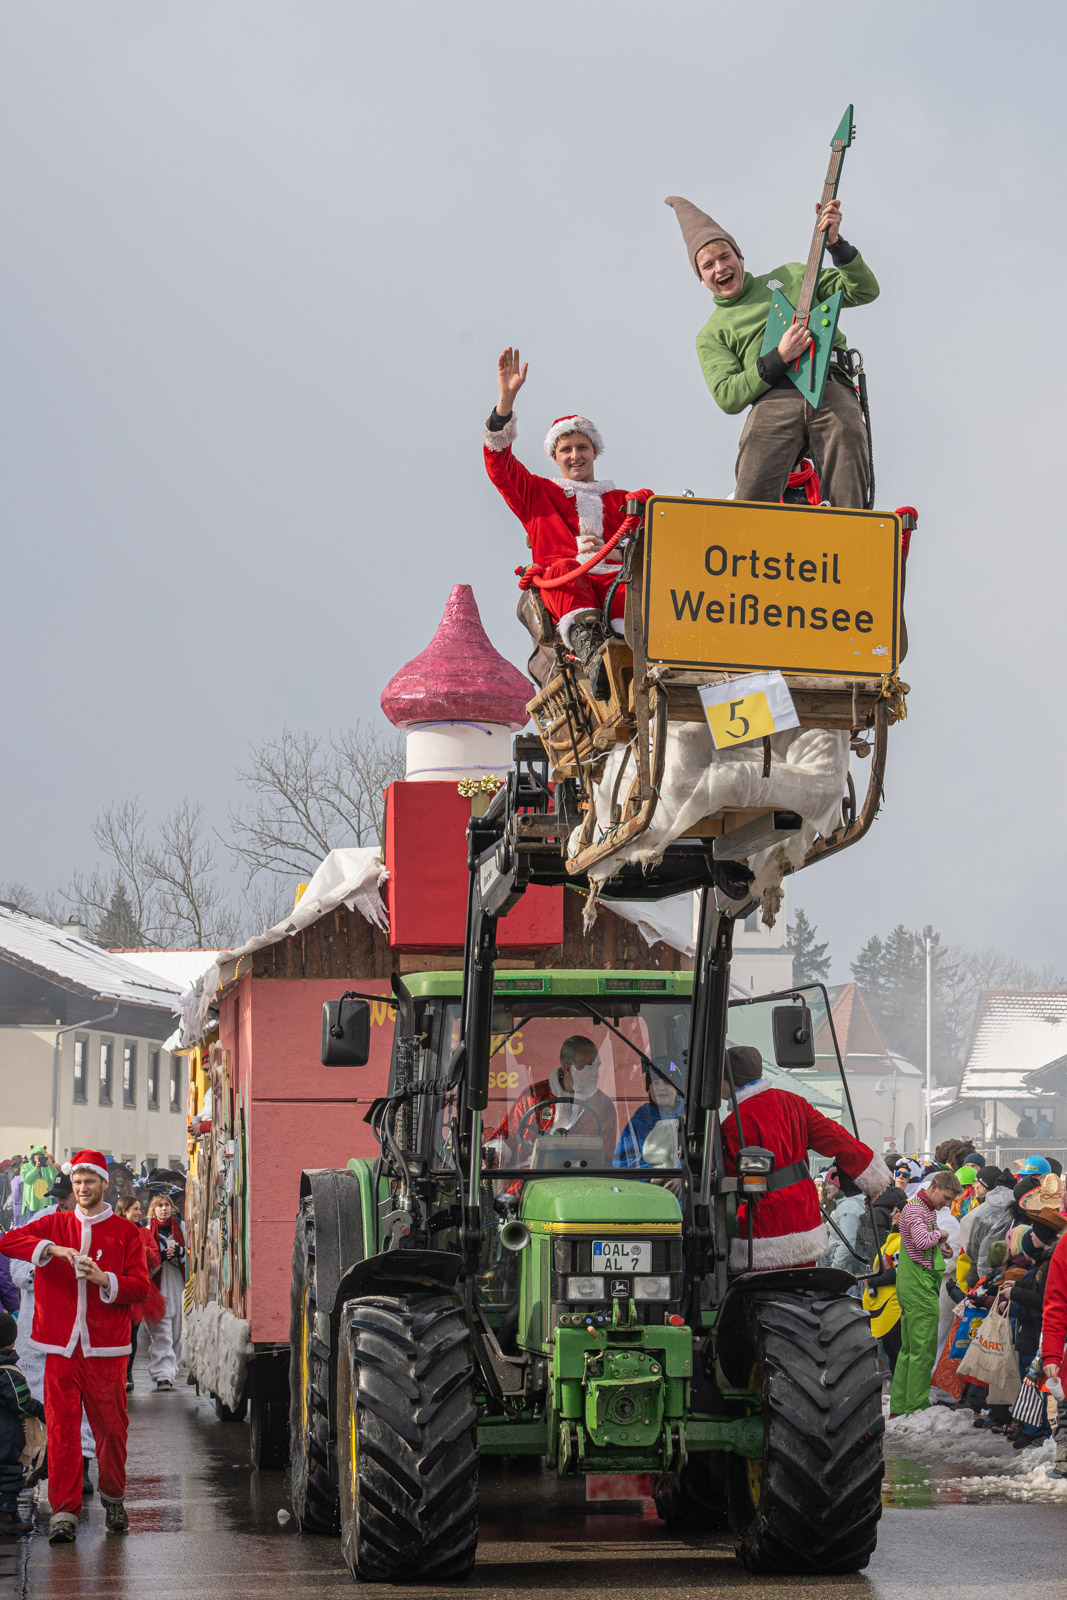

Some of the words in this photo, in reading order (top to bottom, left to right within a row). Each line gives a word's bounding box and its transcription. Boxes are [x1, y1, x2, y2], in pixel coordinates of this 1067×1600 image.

[704, 544, 841, 584] Ortsteil
[670, 589, 874, 633] Weißensee
[725, 699, 750, 739] 5
[603, 1243, 630, 1256] OAL
[604, 1258, 622, 1270] AL
[631, 1258, 639, 1270] 7
